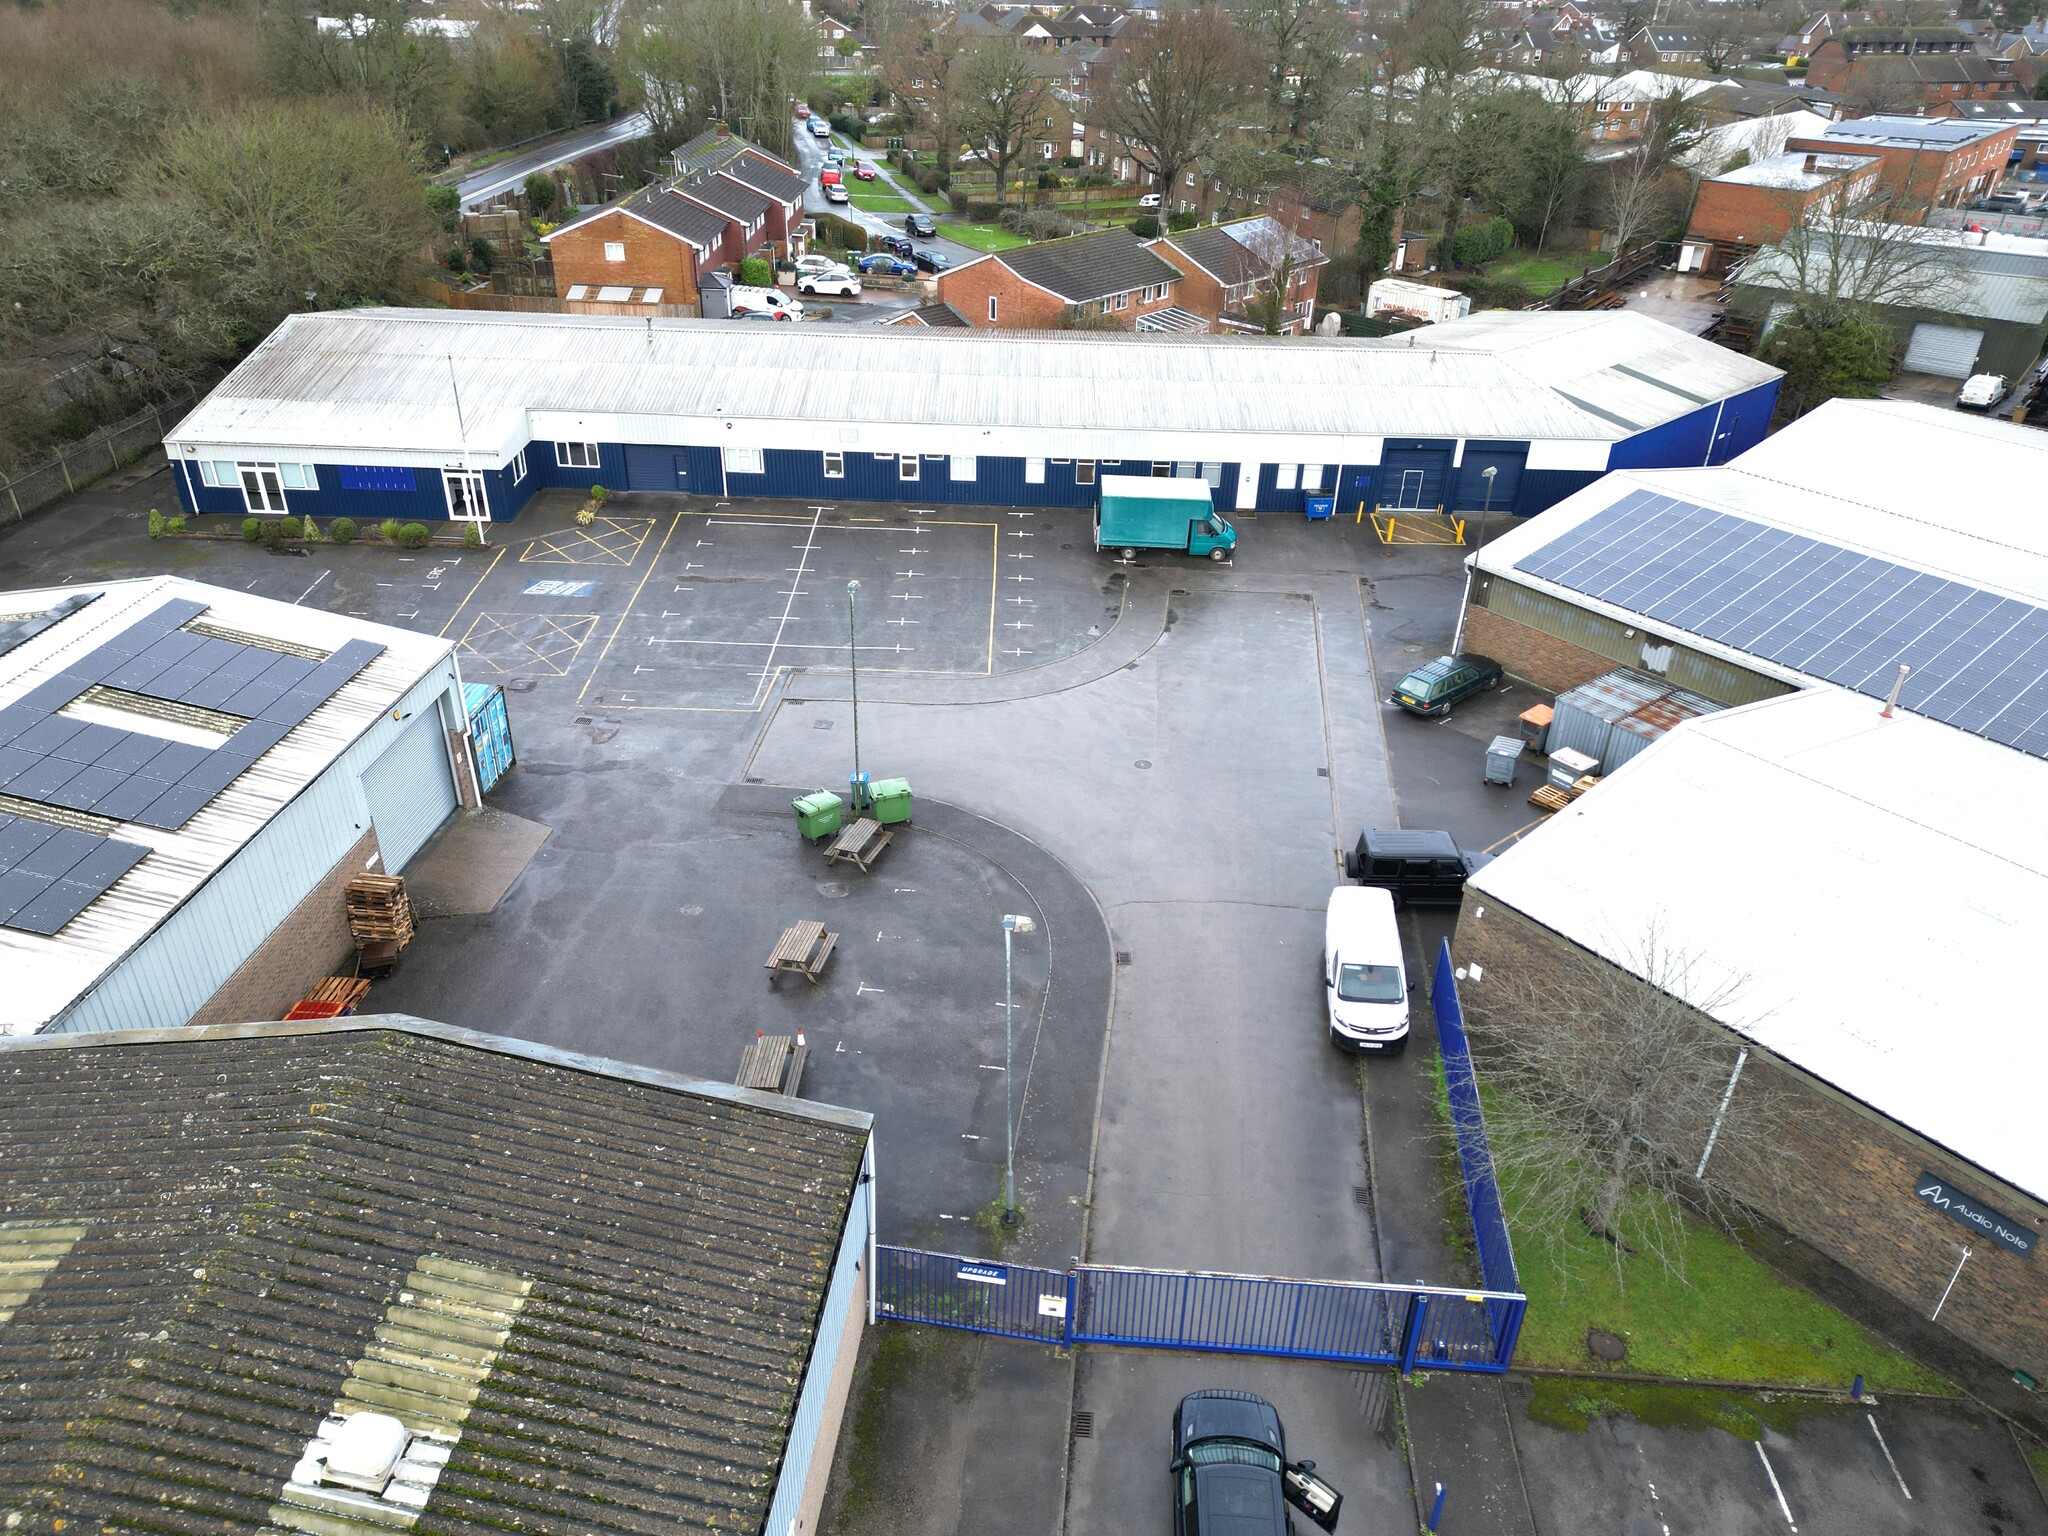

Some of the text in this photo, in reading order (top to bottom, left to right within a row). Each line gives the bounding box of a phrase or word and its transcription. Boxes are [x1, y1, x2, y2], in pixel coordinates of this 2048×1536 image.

[1407, 308, 1428, 317] MING
[1953, 1205, 2027, 1249] Audio Note
[962, 1267, 999, 1276] UPGRADE
